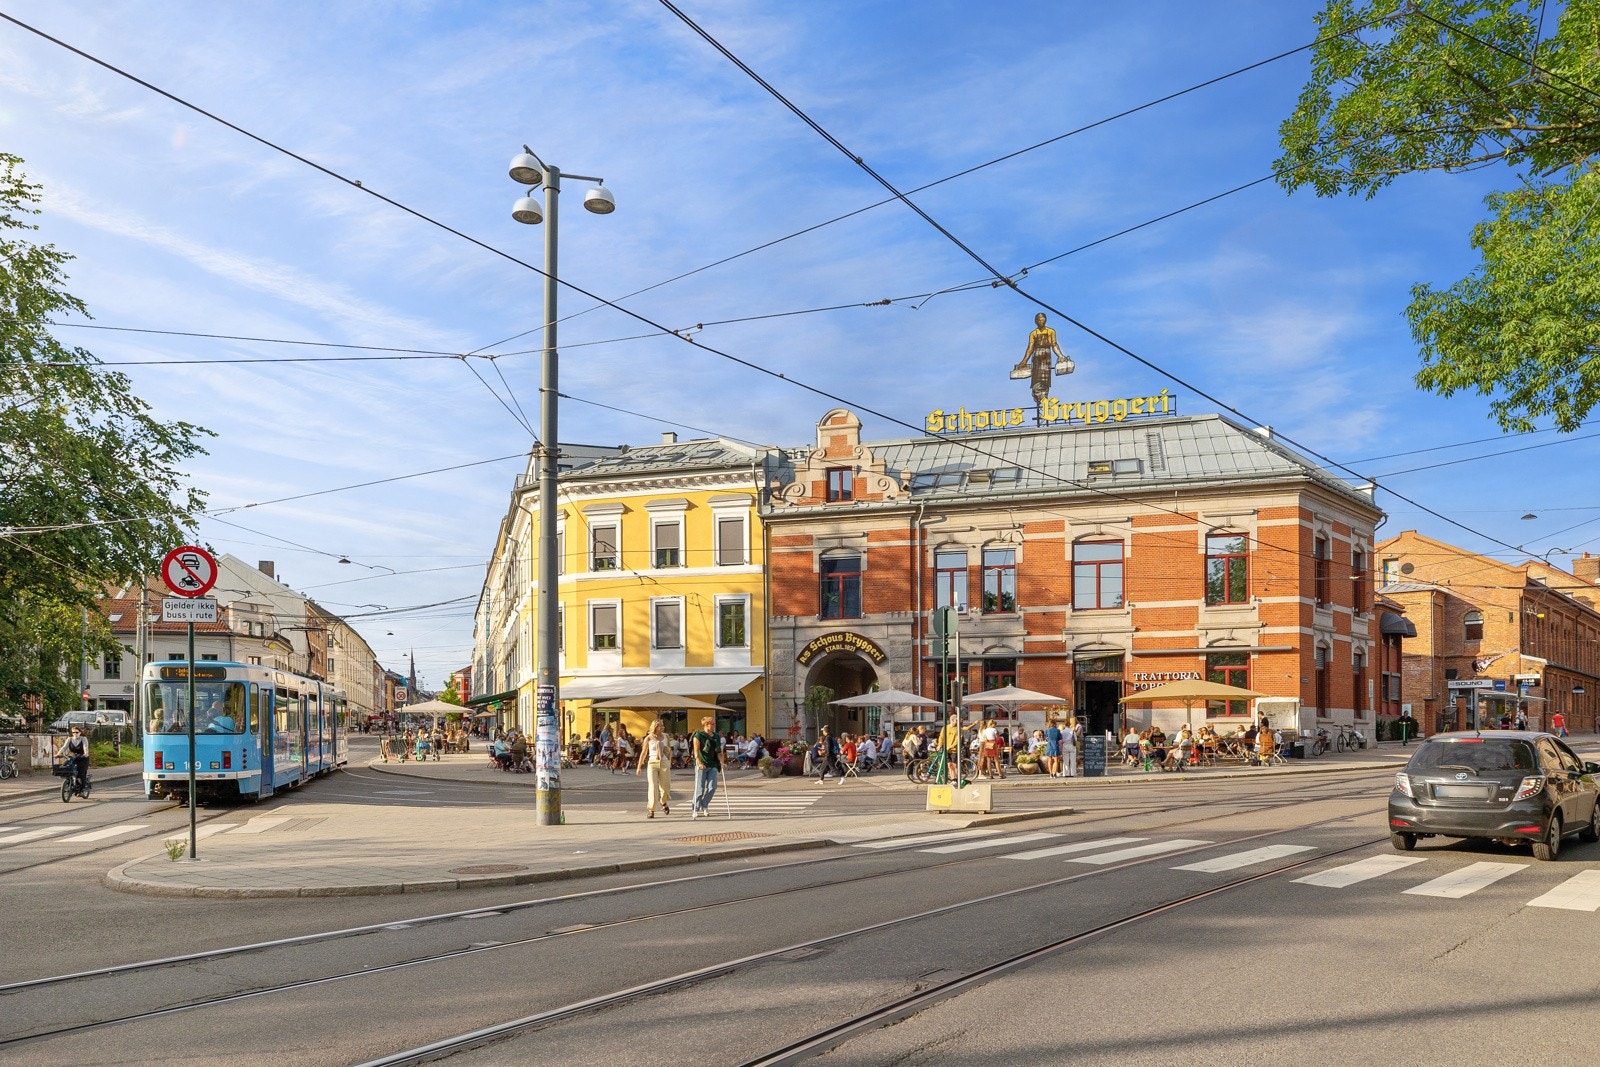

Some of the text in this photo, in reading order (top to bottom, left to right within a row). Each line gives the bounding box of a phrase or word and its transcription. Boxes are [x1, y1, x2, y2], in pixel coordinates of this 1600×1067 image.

[927, 388, 1169, 432] Schous Bryggeri
[164, 601, 195, 610] Gjelder
[809, 634, 844, 651] Schous
[845, 632, 884, 661] Bryggeri
[1133, 672, 1200, 680] TRATTORIA
[1133, 682, 1169, 690] POPO
